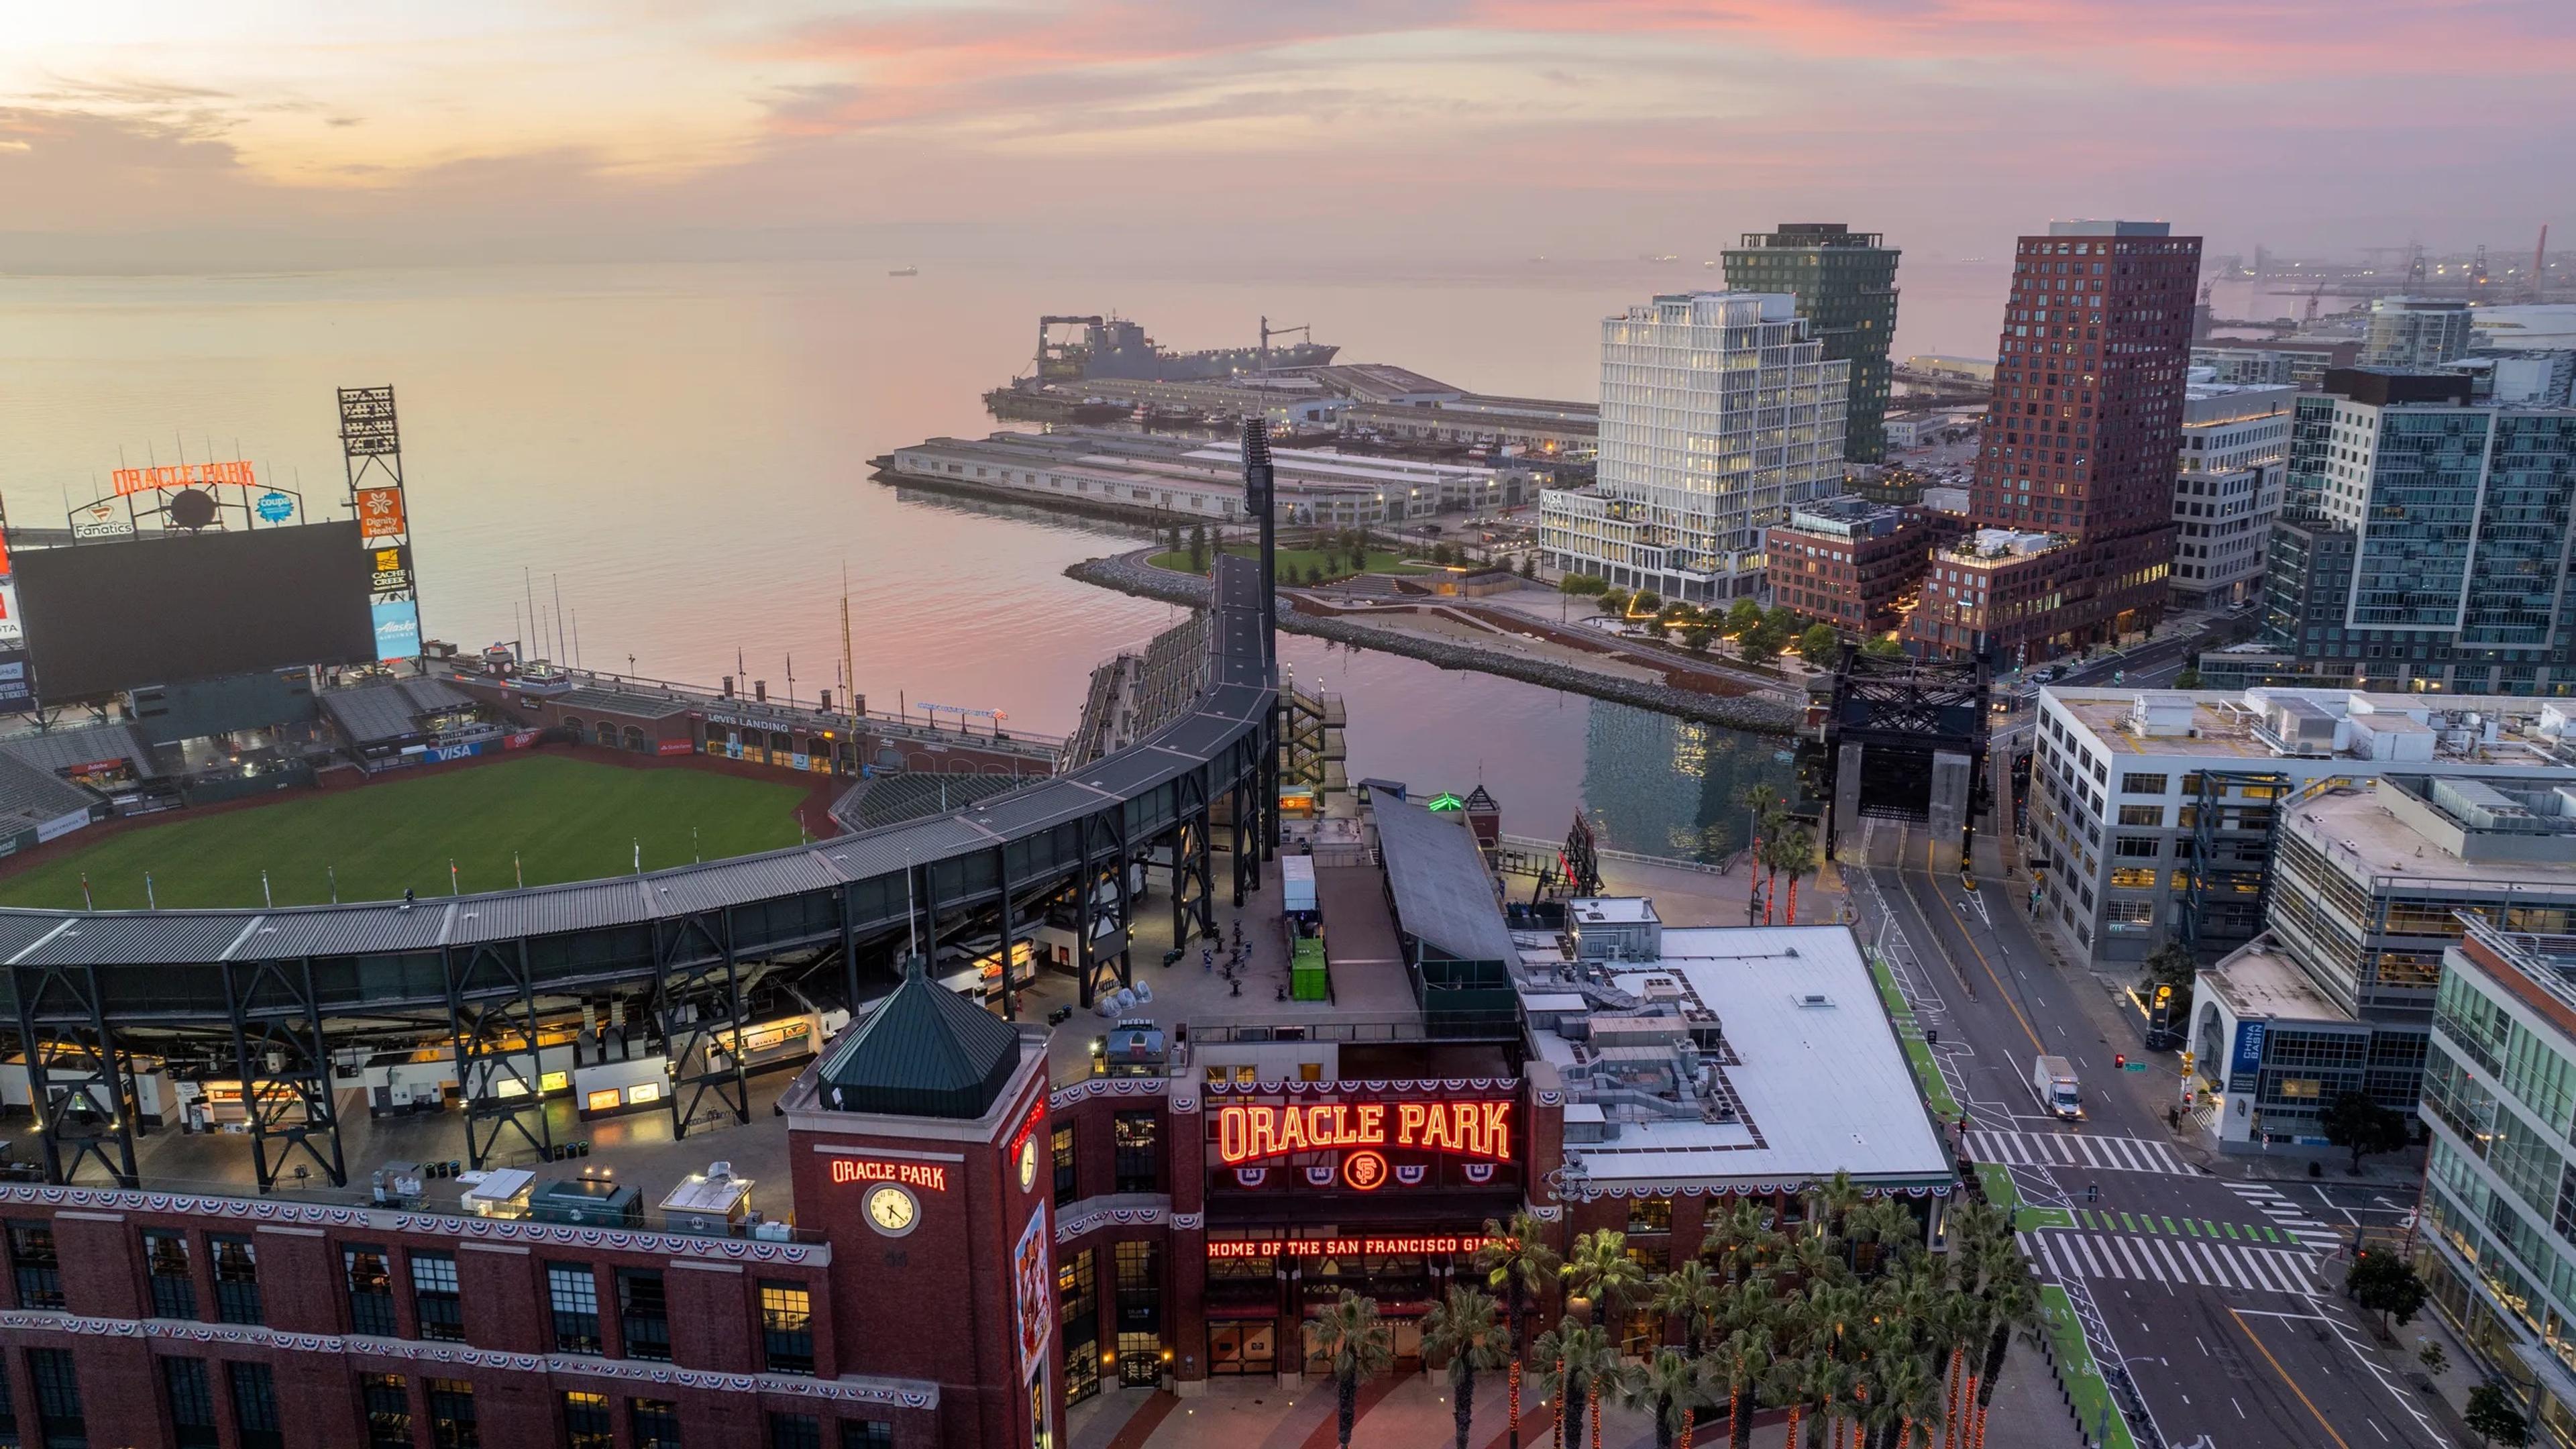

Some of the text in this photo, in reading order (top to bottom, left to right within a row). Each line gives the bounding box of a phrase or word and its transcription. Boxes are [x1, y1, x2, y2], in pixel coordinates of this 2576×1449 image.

[111, 461, 256, 496] ORACLE PARK
[261, 498, 291, 506] coupa
[1542, 492, 1562, 504] VISA
[366, 517, 397, 526] Dignity
[76, 523, 132, 537] Fanatics
[369, 526, 398, 535] Health
[372, 570, 406, 579] CACHE
[374, 577, 406, 586] CREEK
[376, 620, 416, 633] Alaska
[5, 690, 29, 699] TICKETS
[740, 718, 789, 733] LANDING
[437, 745, 472, 761] VISA
[2243, 1025, 2254, 1059] CHINA
[2251, 1024, 2262, 1059] BASIN
[1220, 1102, 1510, 1162] ORACLE PARK
[833, 1160, 945, 1191] ORACLE PARK
[1208, 1243, 1254, 1256] HOME
[1262, 1242, 1281, 1256] OF
[1288, 1242, 1320, 1254] THE
[1327, 1240, 1359, 1254] SAN
[1366, 1239, 1456, 1253] FRANCISCO
